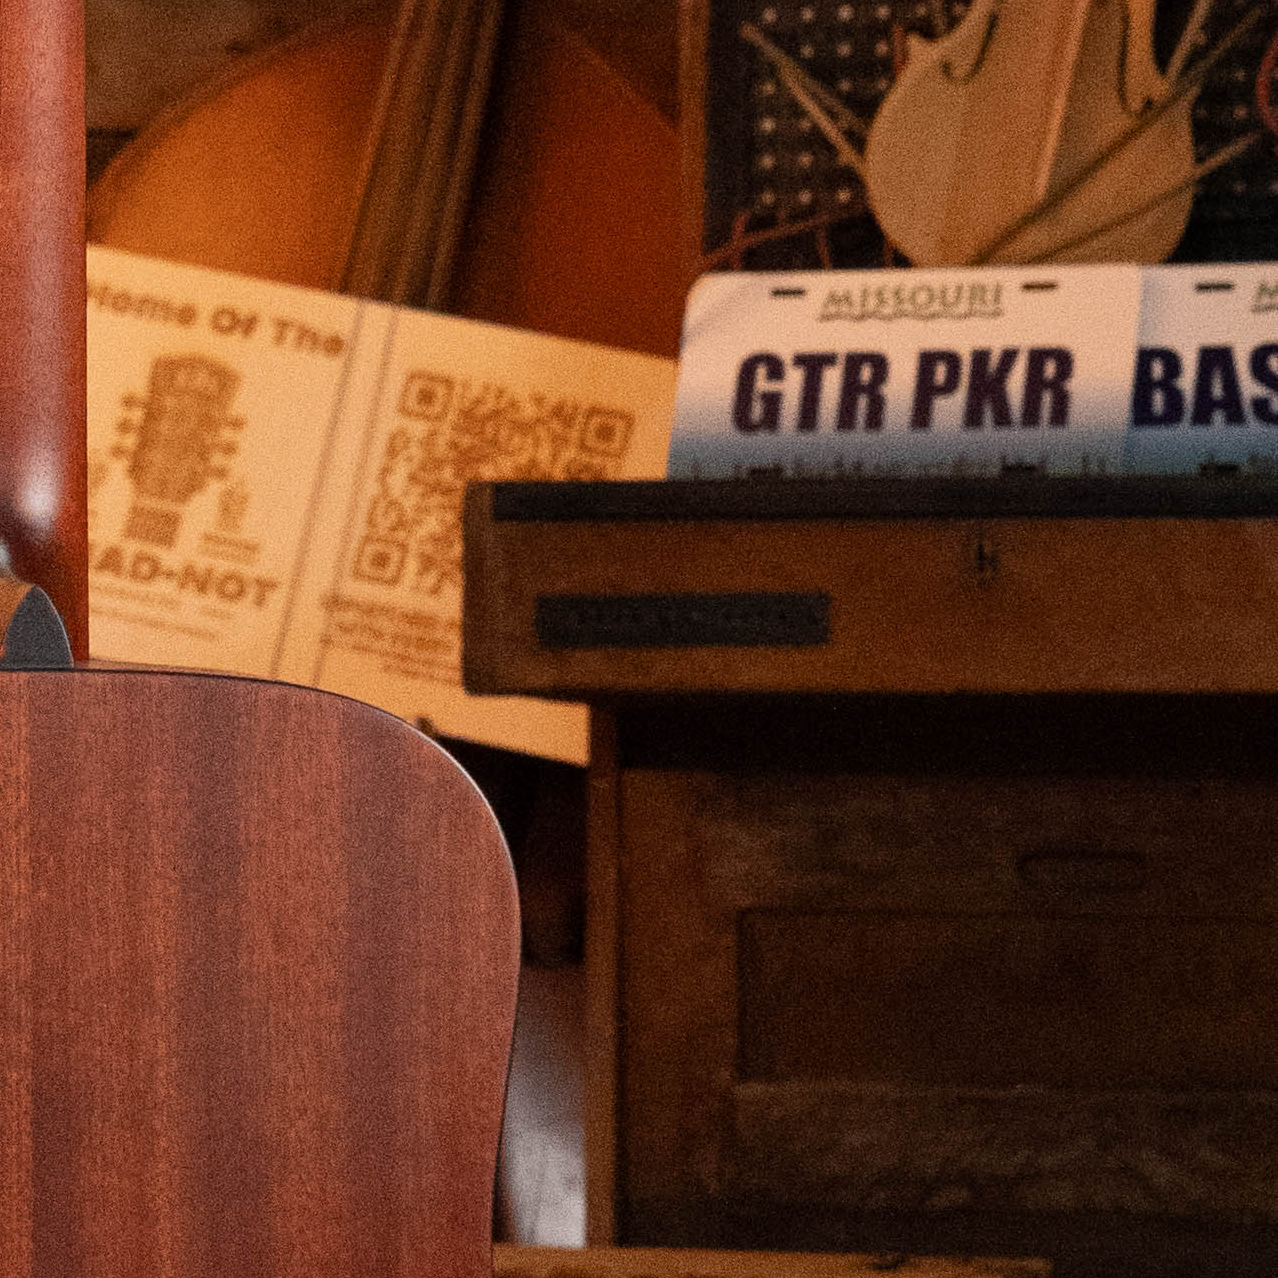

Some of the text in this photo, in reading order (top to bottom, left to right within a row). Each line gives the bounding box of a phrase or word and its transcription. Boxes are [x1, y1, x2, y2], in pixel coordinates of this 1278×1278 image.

[823, 280, 1006, 314] MISSOURI
[271, 316, 348, 358] The
[731, 345, 1076, 433] GTR PKR
